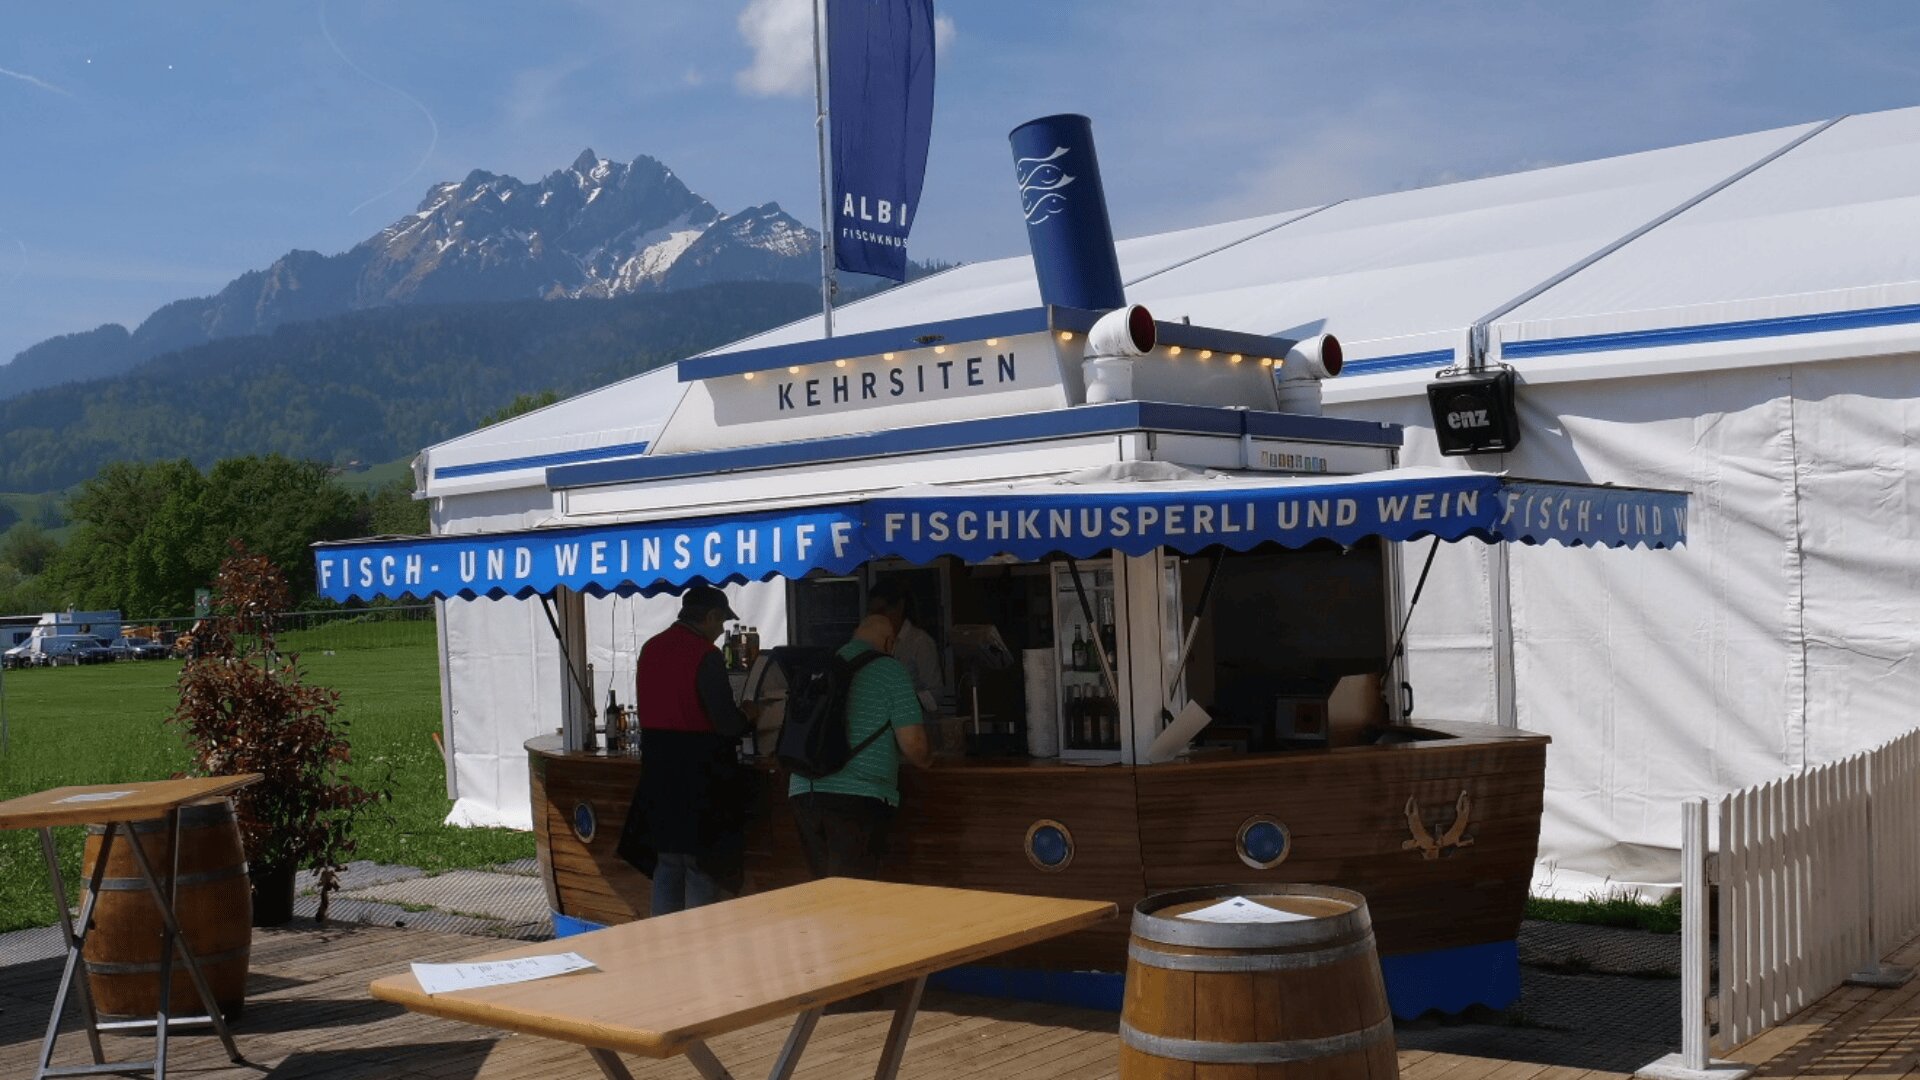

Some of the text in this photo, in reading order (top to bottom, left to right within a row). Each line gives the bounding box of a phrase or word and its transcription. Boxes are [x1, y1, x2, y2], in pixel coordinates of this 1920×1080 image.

[843, 193, 907, 227] ALBI
[778, 353, 1015, 410] KEHRSITEN
[1447, 410, 1490, 429] enz
[885, 490, 1479, 542] FISCHKNUSPERLI UND WEIN
[1501, 493, 1602, 531] FISCH-
[1616, 503, 1663, 536] UND
[321, 522, 853, 589] FISCH- UND WEINSCHIFF
